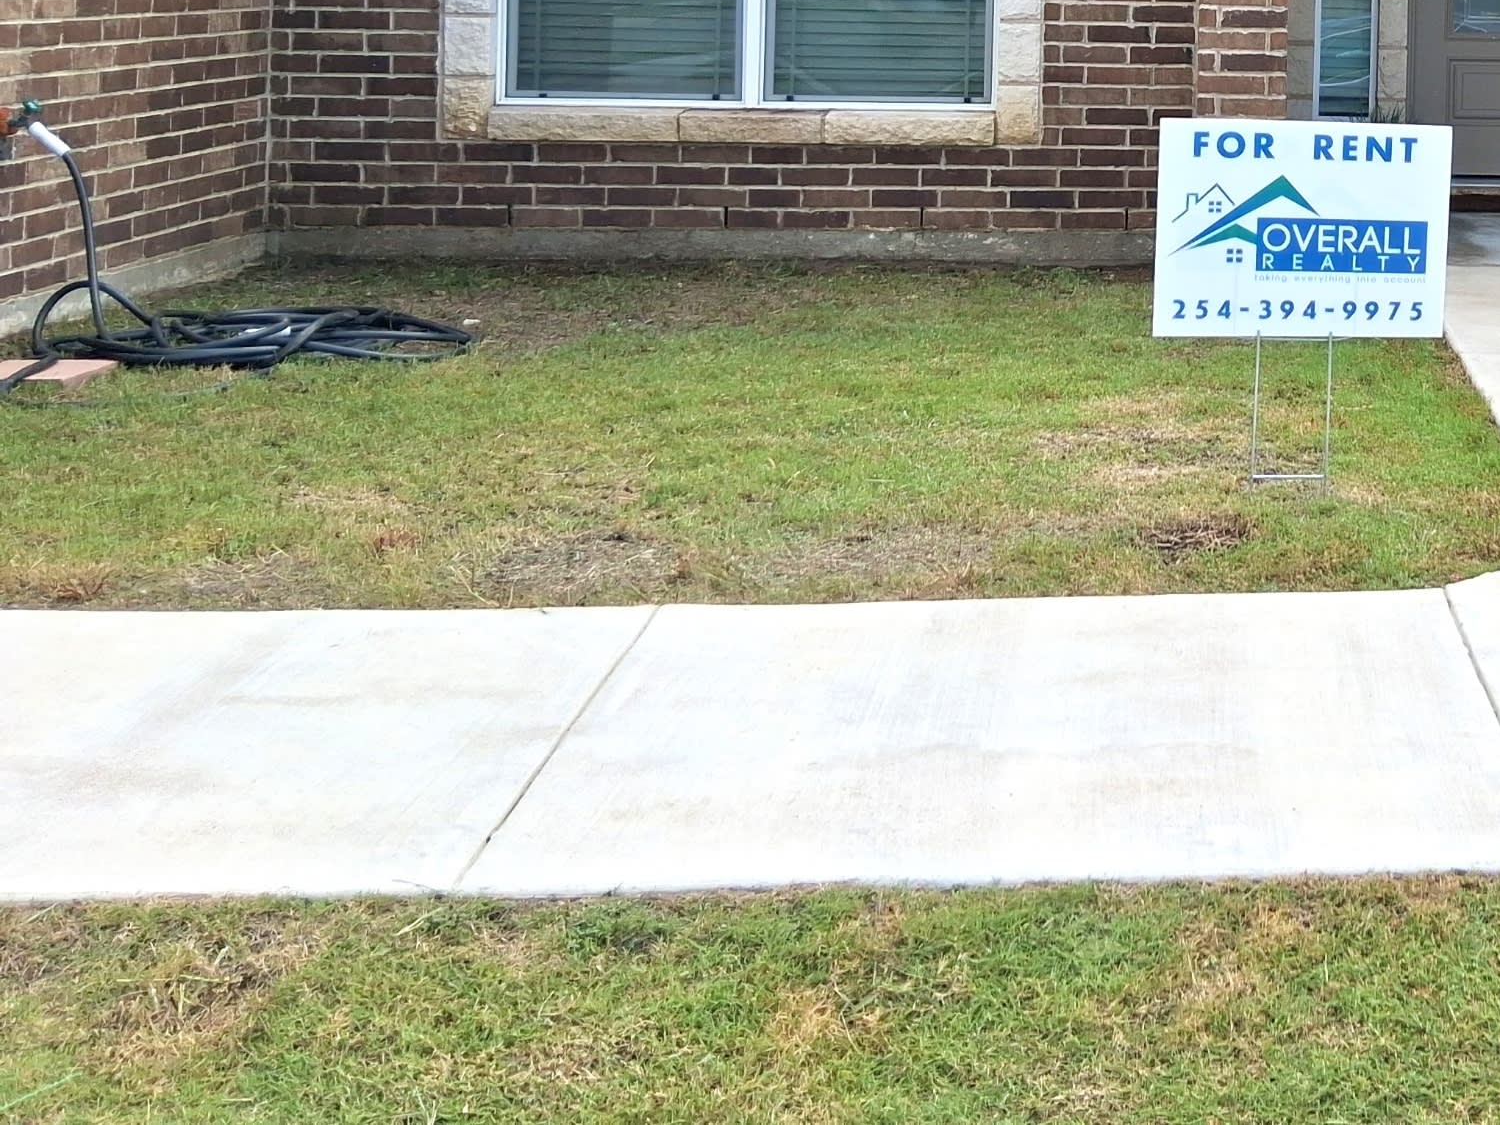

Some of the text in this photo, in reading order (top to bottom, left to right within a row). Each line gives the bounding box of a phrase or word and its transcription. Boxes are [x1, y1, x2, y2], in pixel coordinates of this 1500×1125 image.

[1193, 131, 1418, 163] FOR RENT
[1262, 223, 1421, 254] OVERALL
[1262, 253, 1420, 272] REALTY
[1294, 275, 1351, 284] everything
[1172, 299, 1424, 321] 254-394-9975
